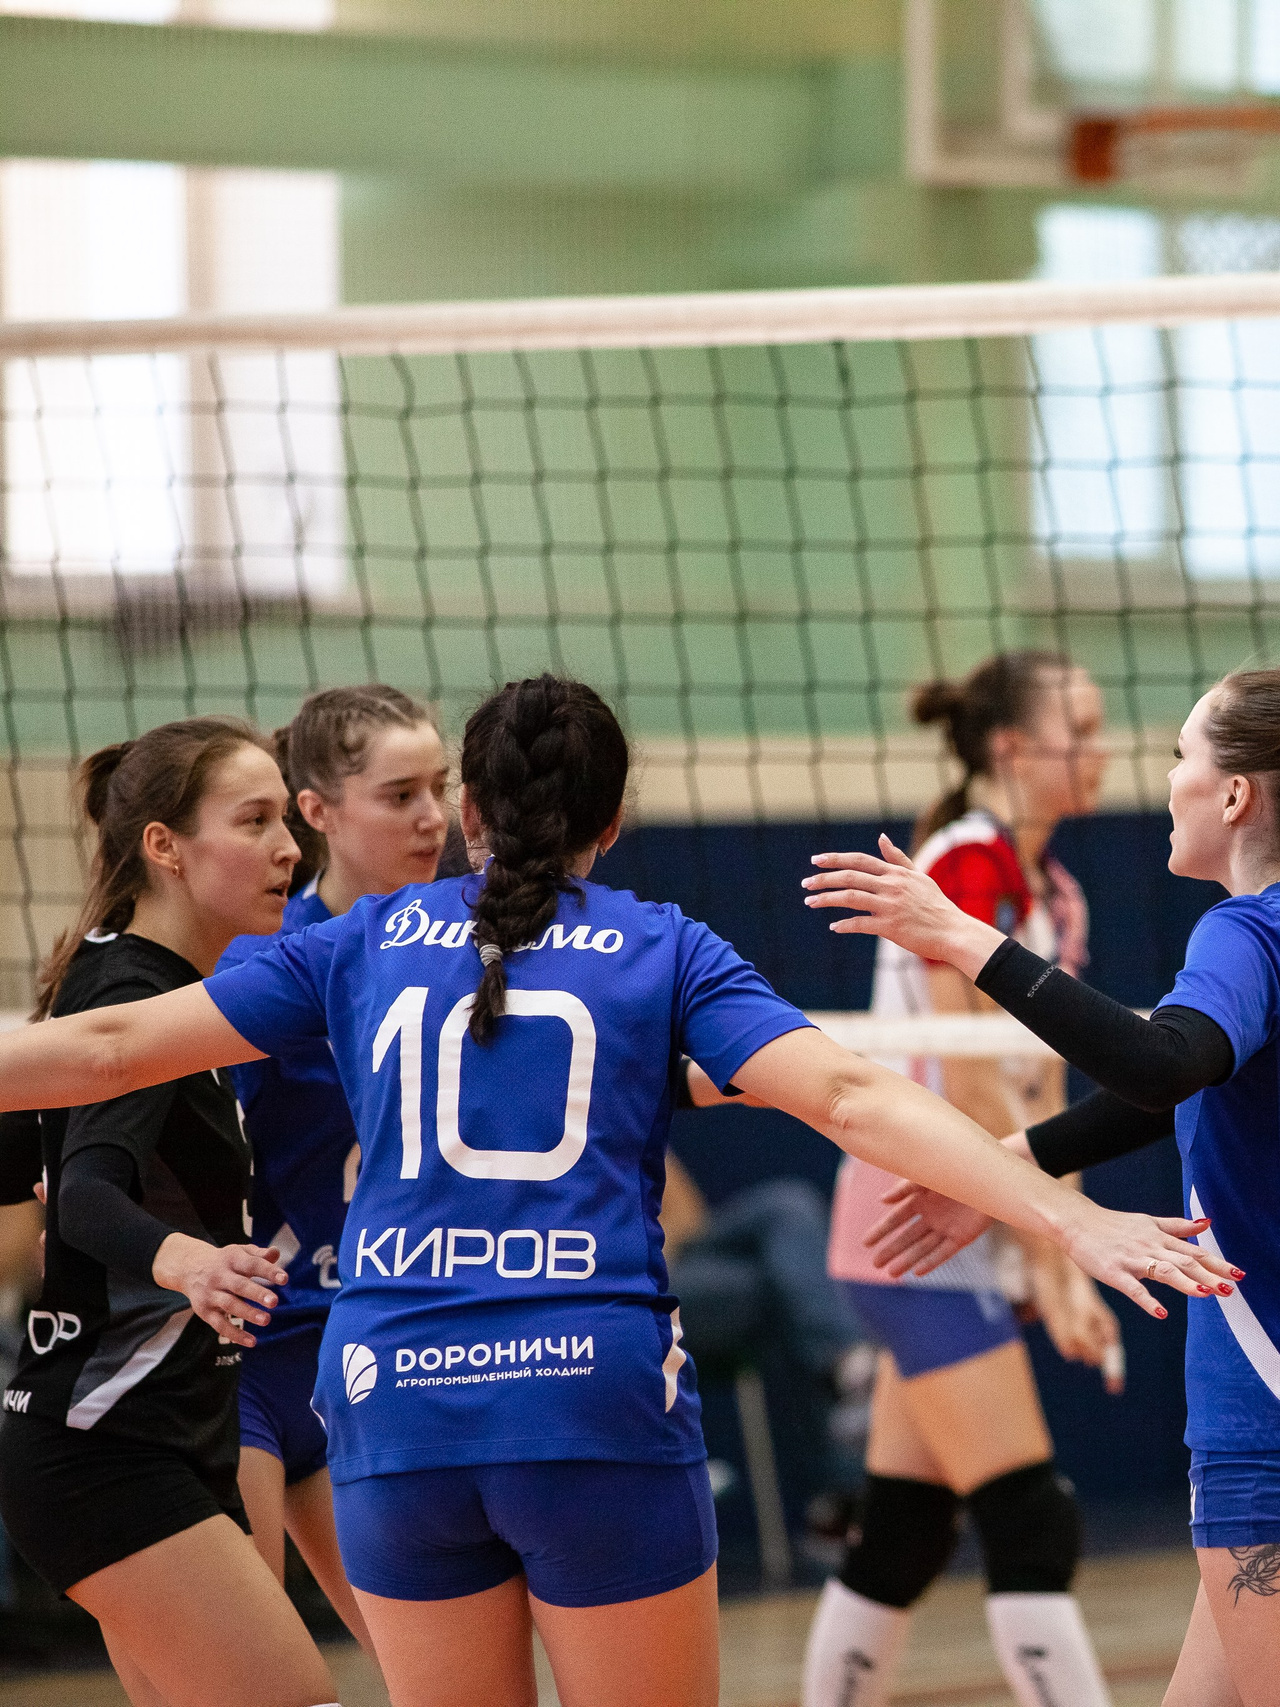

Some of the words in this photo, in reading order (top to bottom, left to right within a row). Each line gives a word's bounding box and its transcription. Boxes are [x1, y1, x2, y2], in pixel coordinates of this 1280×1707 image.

[380, 899, 623, 954] Димо
[372, 987, 596, 1181] 10
[355, 1227, 596, 1280] КИРОВ
[396, 1367, 531, 1388] АГРОПРОМЫШЛЕННЫЙ
[536, 1367, 594, 1377] ХОЛДИНГ
